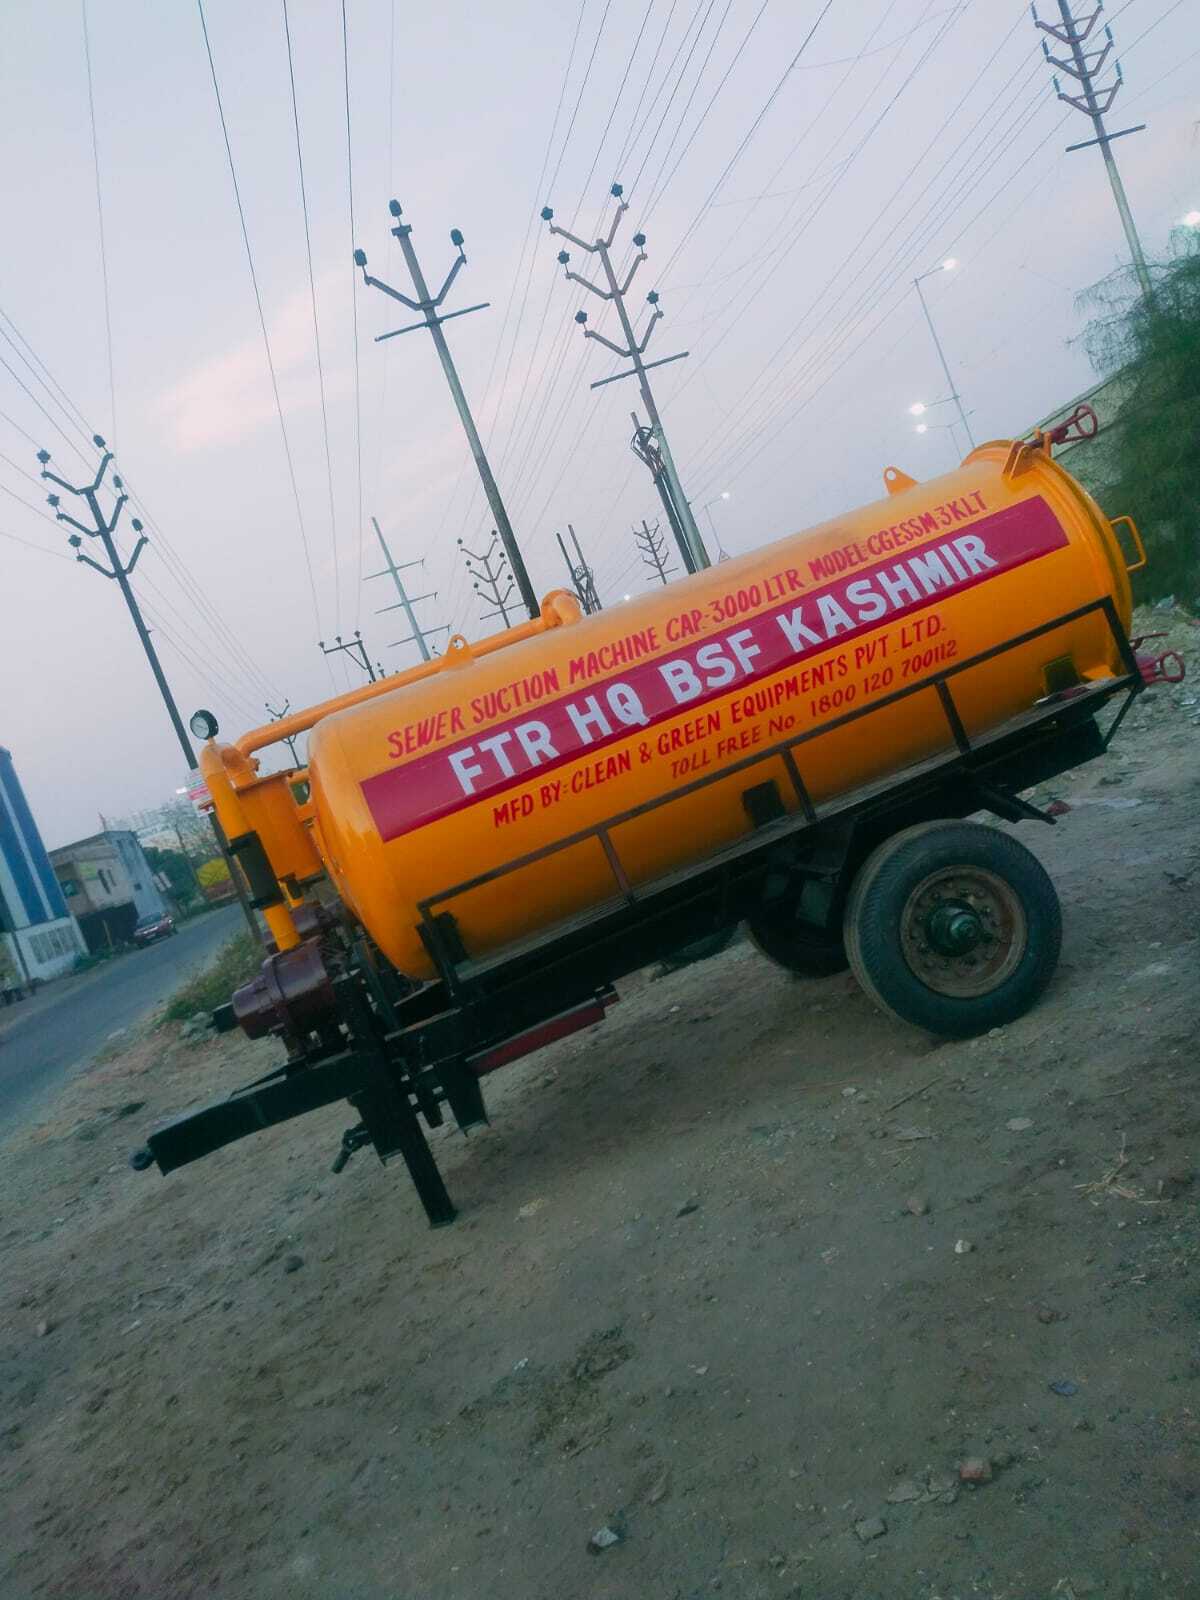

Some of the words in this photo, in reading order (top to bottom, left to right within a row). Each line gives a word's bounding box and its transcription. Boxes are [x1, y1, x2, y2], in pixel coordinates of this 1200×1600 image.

[387, 706, 465, 759] SEWER
[470, 667, 560, 724] SUCTION
[569, 626, 661, 684] MACHINE
[448, 721, 560, 796] FTR
[566, 682, 649, 745] HQ
[658, 629, 761, 704] BSF
[776, 535, 999, 653] KASHMIR
[493, 794, 534, 828] MFD
[638, 742, 651, 763] &
[658, 710, 721, 756] GREEN
[731, 654, 849, 724] EQUIPMENTS
[671, 751, 710, 779] TOLL
[717, 725, 761, 759] FREE
[811, 684, 856, 717] 1800
[864, 667, 893, 694] 120
[902, 640, 957, 677] 700112
